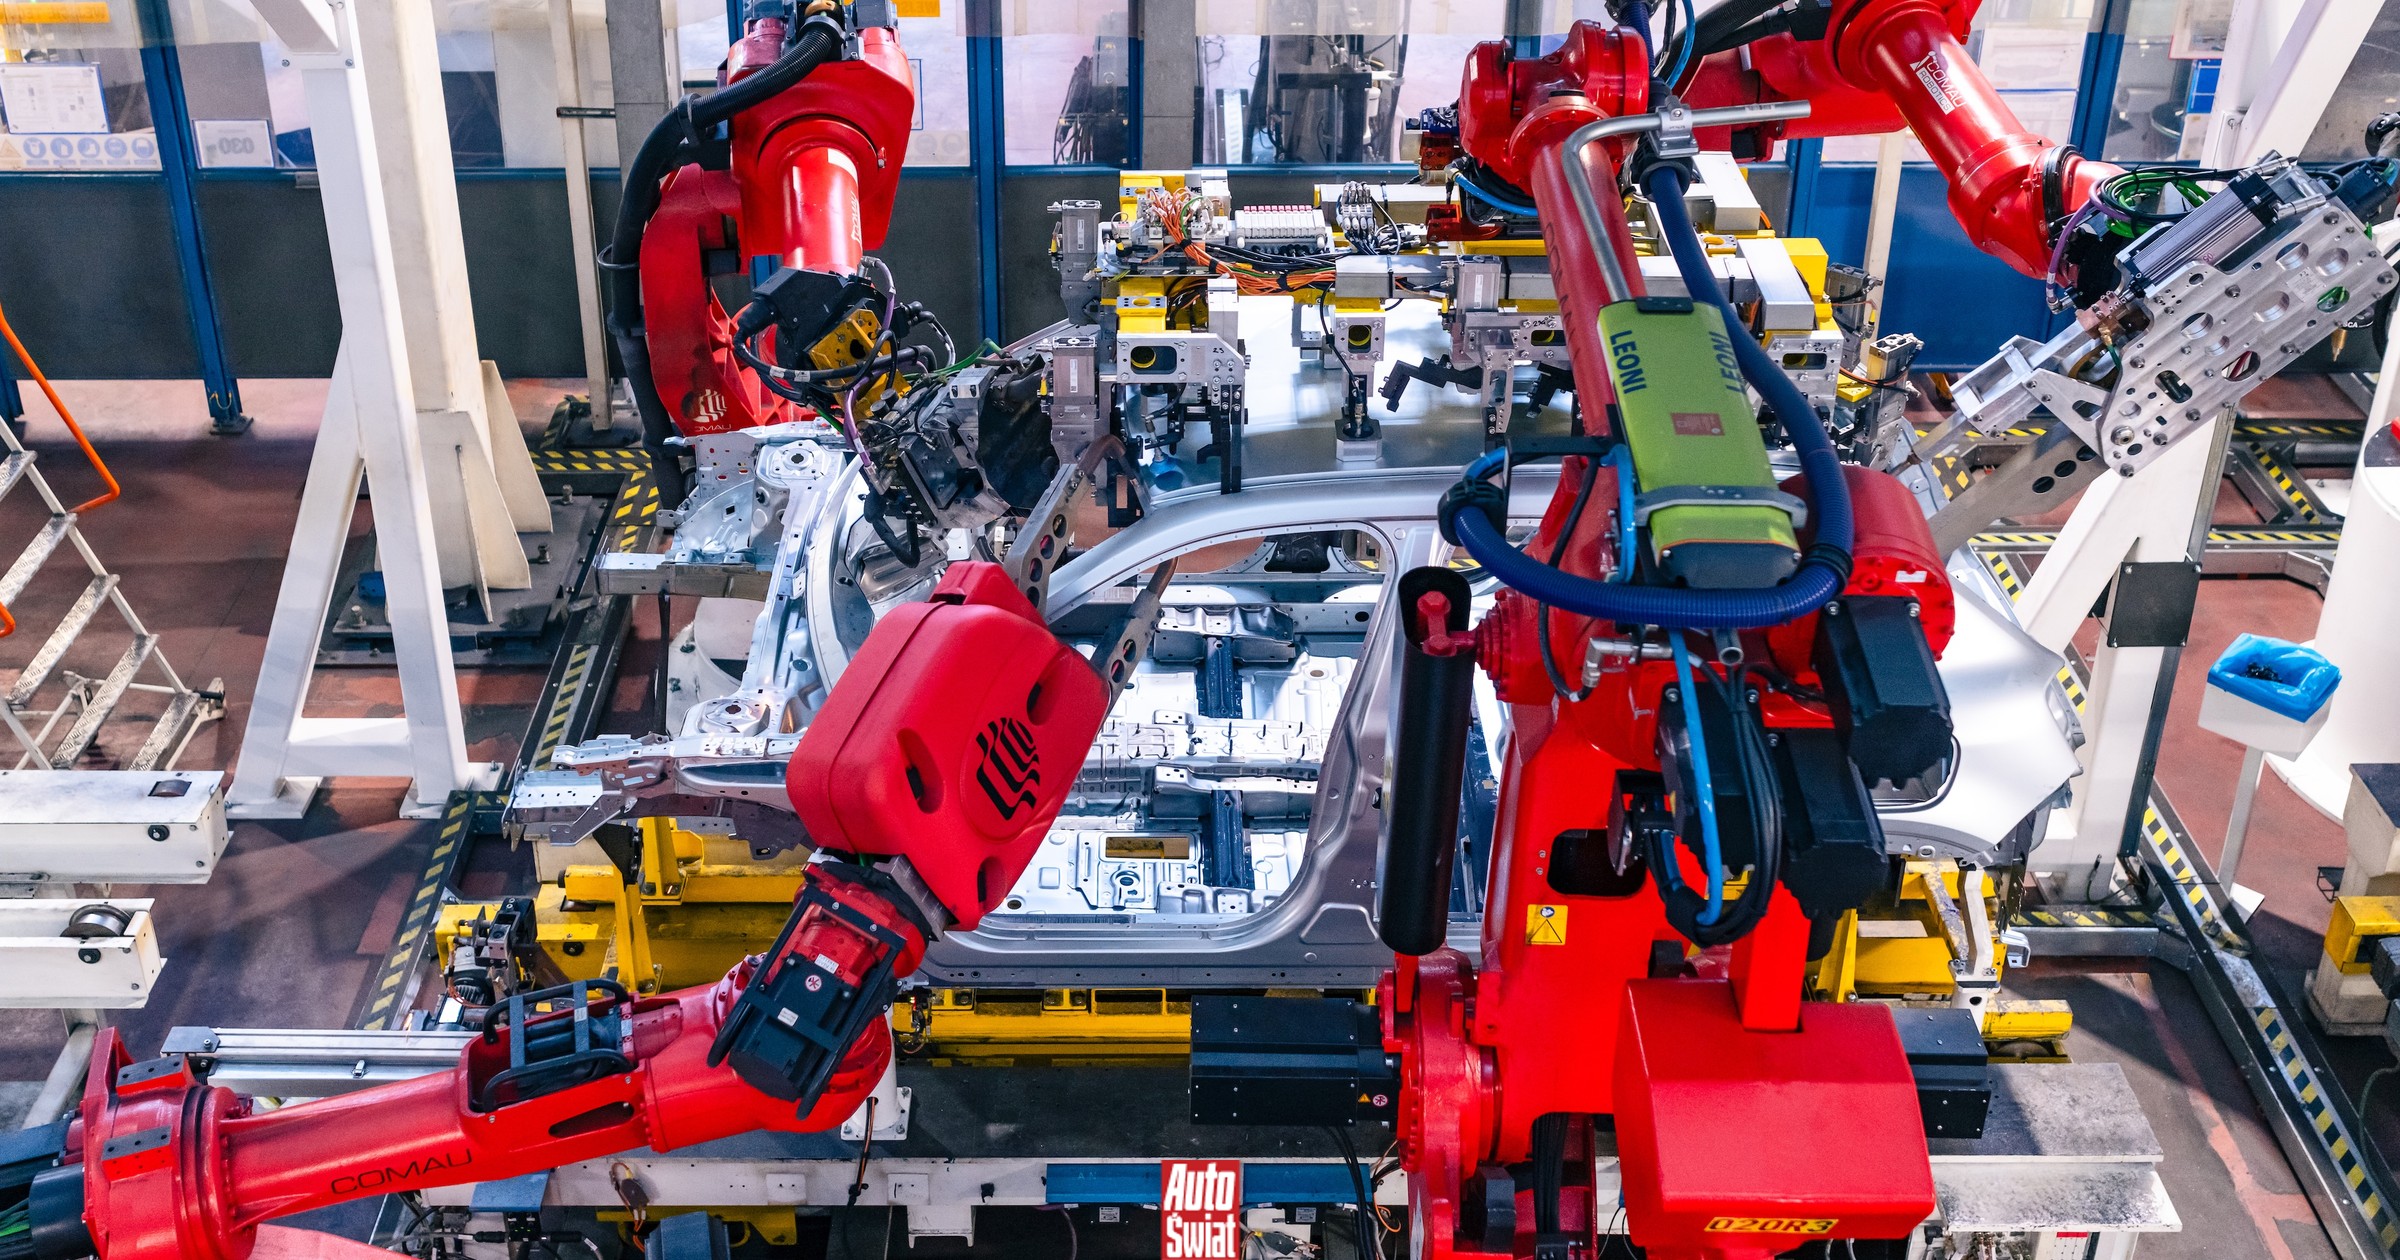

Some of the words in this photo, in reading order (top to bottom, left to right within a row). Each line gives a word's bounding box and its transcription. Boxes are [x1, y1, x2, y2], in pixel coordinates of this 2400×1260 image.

[1919, 70, 1951, 111] ROBOTICS
[1926, 61, 1967, 108] COMAU
[1610, 330, 1647, 394] LEONI
[1709, 331, 1746, 395] LEONI
[331, 1148, 473, 1195] COMAU
